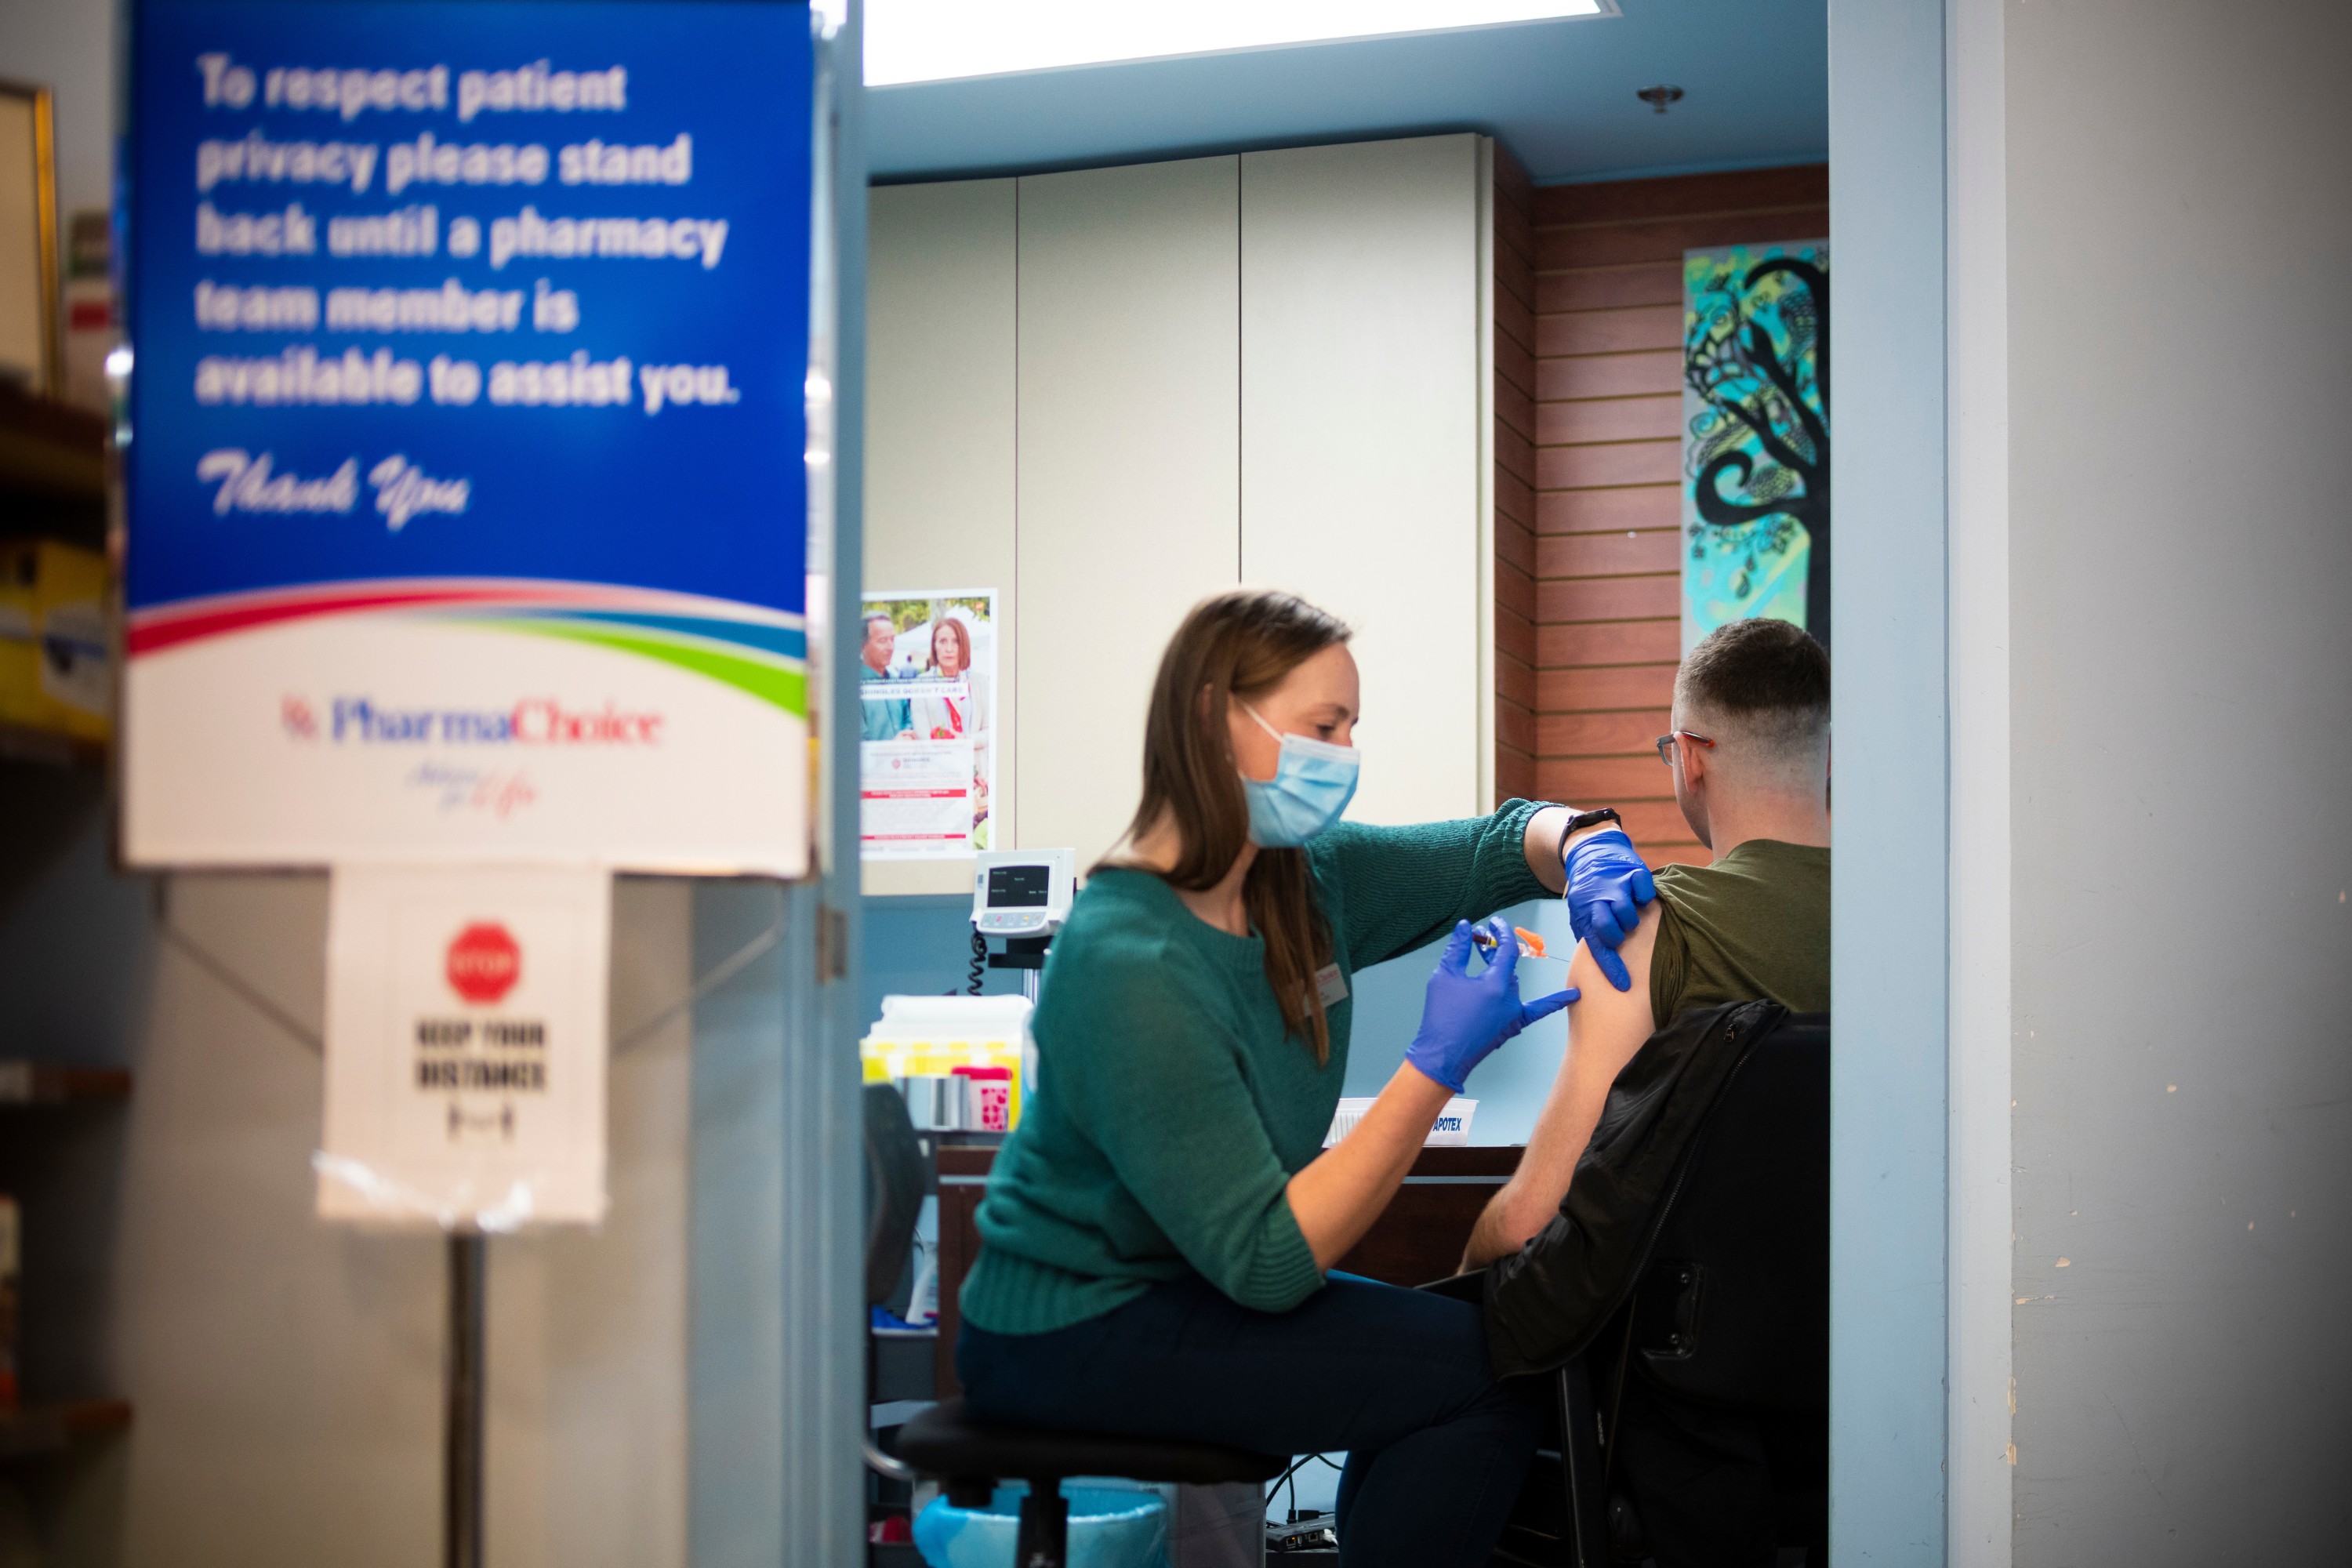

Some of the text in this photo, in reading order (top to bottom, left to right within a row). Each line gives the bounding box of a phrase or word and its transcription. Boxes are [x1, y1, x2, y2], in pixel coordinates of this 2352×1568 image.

[198, 53, 627, 122] To respect patient
[198, 129, 691, 194] privacy please stand
[197, 201, 728, 268] back until a pharmacy
[195, 279, 579, 332] team member is
[195, 347, 739, 414] available to assist you.
[197, 448, 468, 528] Thank You
[941, 685, 964, 694] CARE
[329, 695, 665, 746] PharmaChoice
[448, 949, 514, 974] STOP
[416, 1021, 546, 1048] KEEP YOUR
[415, 1058, 546, 1091] DISTANCE
[1433, 1117, 1462, 1131] APOTEX
